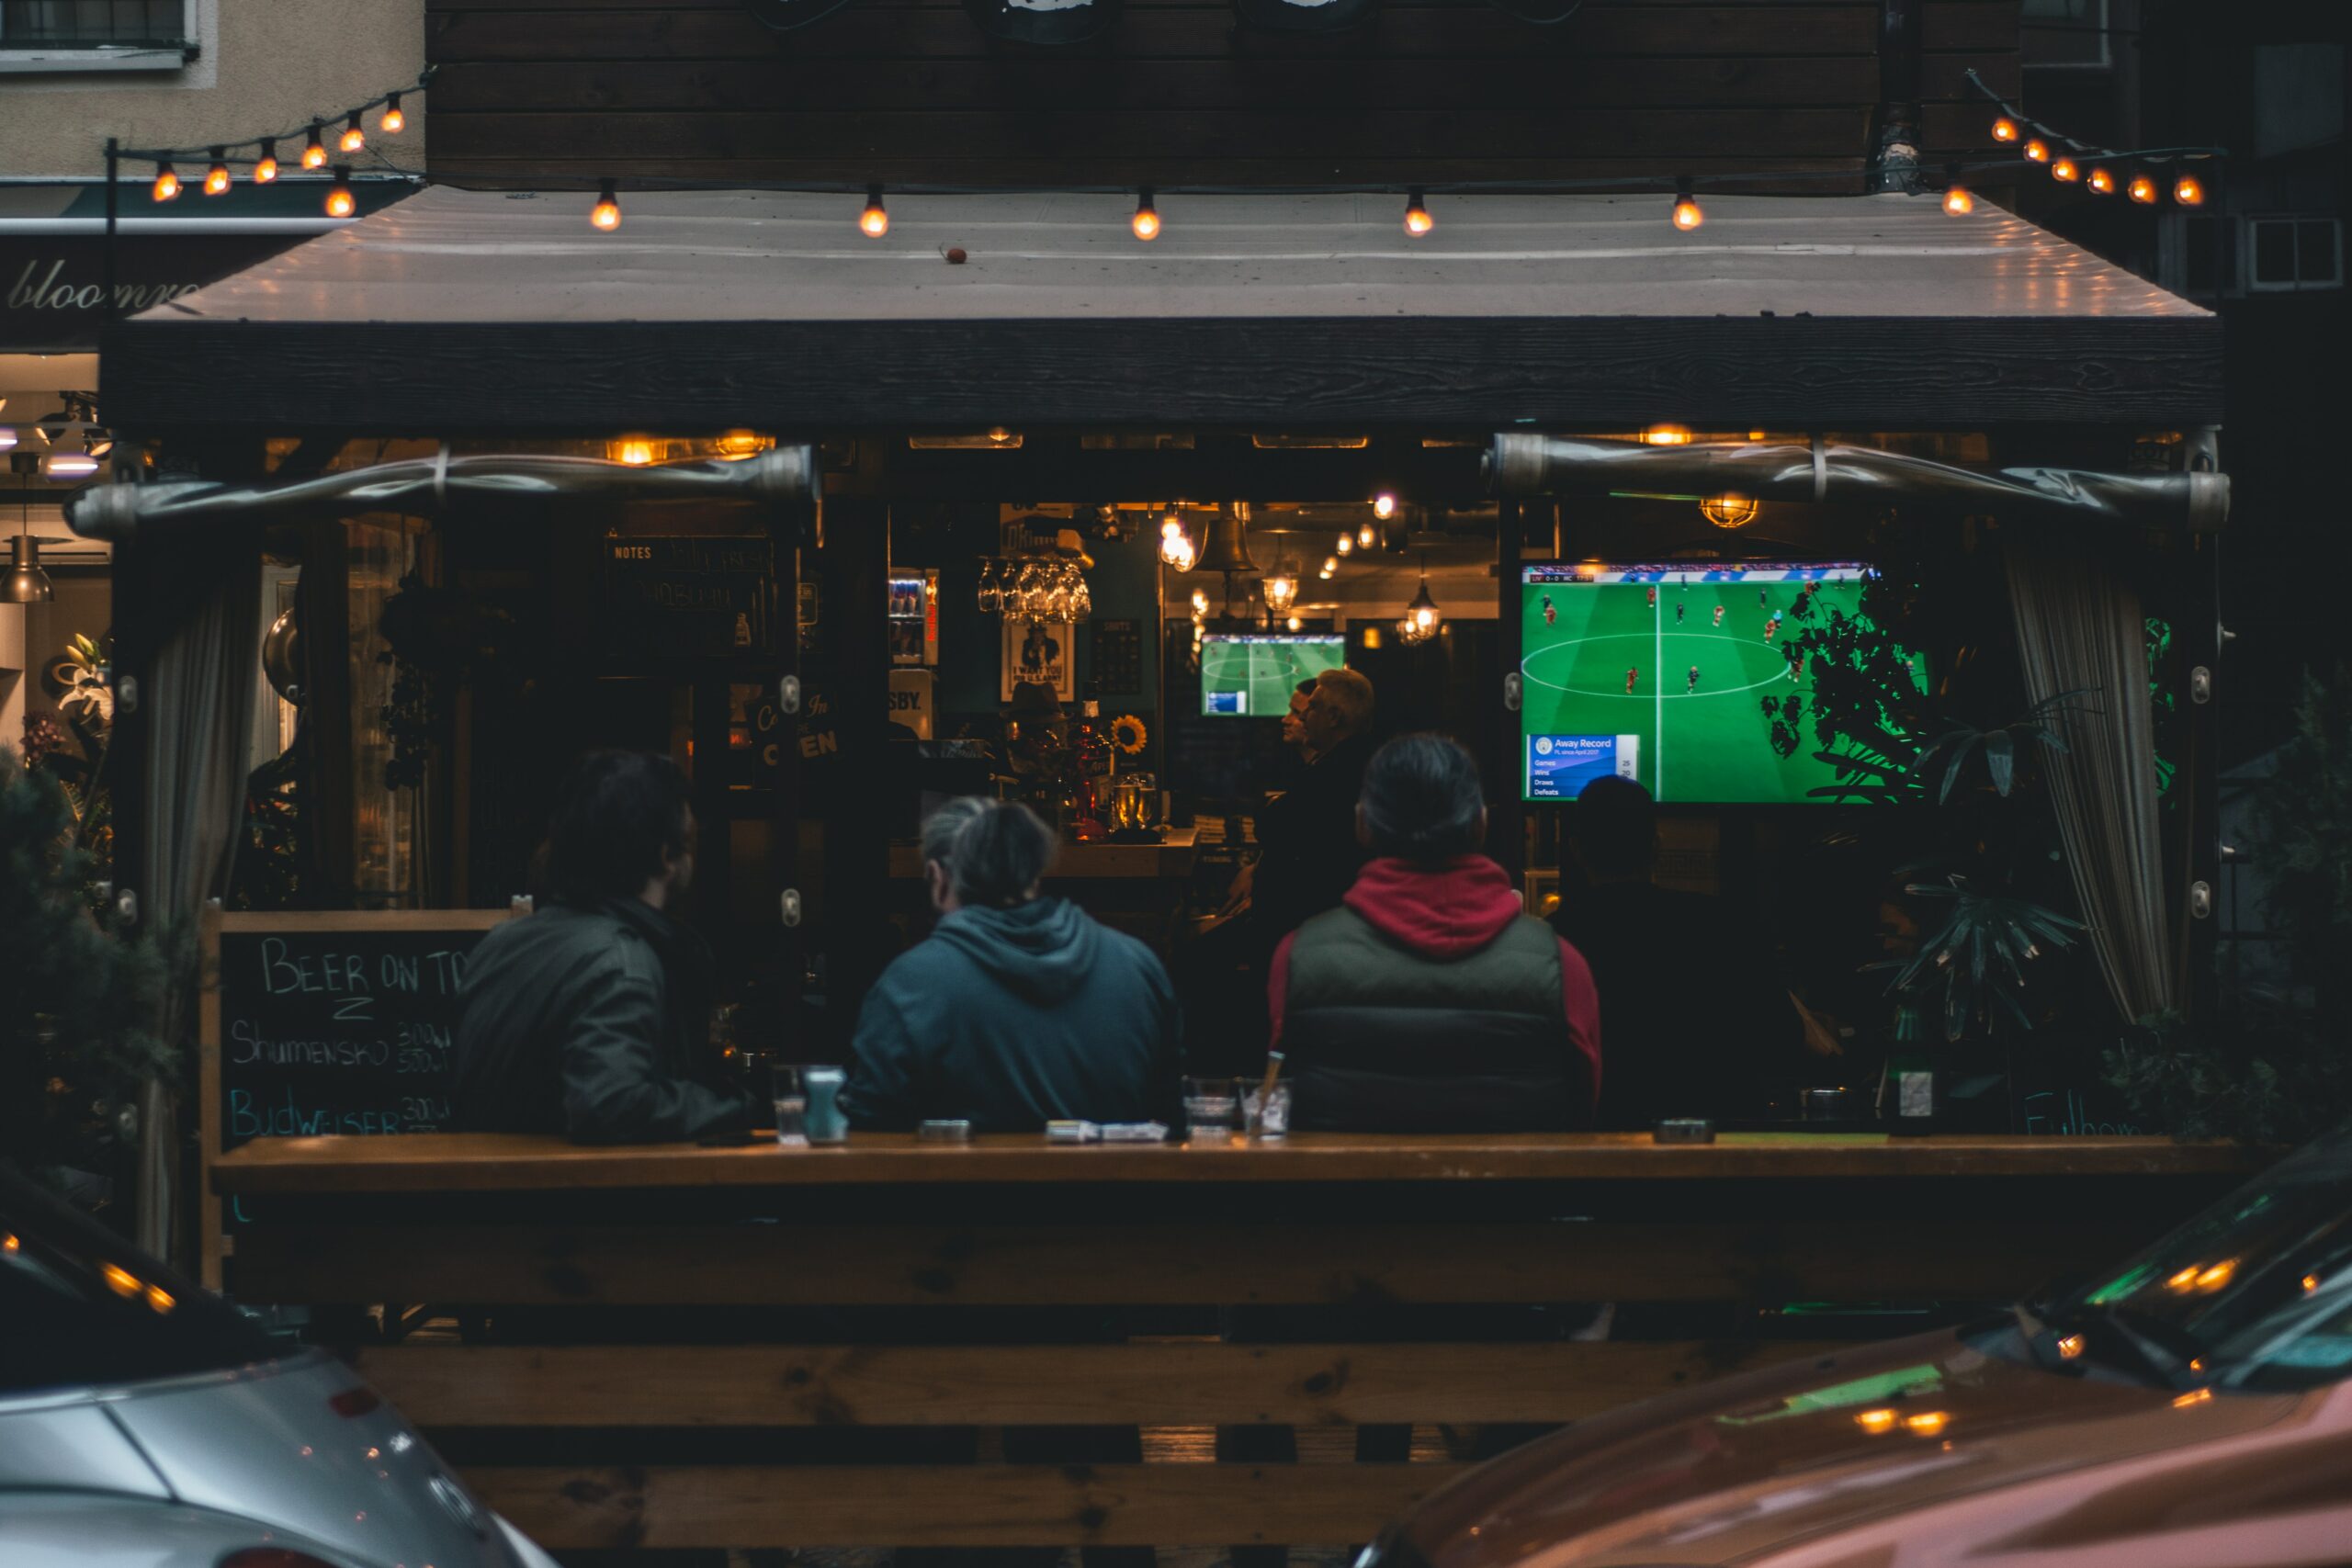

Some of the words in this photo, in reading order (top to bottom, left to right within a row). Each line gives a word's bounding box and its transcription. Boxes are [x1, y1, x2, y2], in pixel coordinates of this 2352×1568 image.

[614, 546, 651, 558] NOTES
[763, 730, 838, 766] OEN
[1555, 739, 1578, 749] Away
[1580, 739, 1611, 748] Record
[261, 937, 368, 994] BEER
[380, 953, 420, 992] ON
